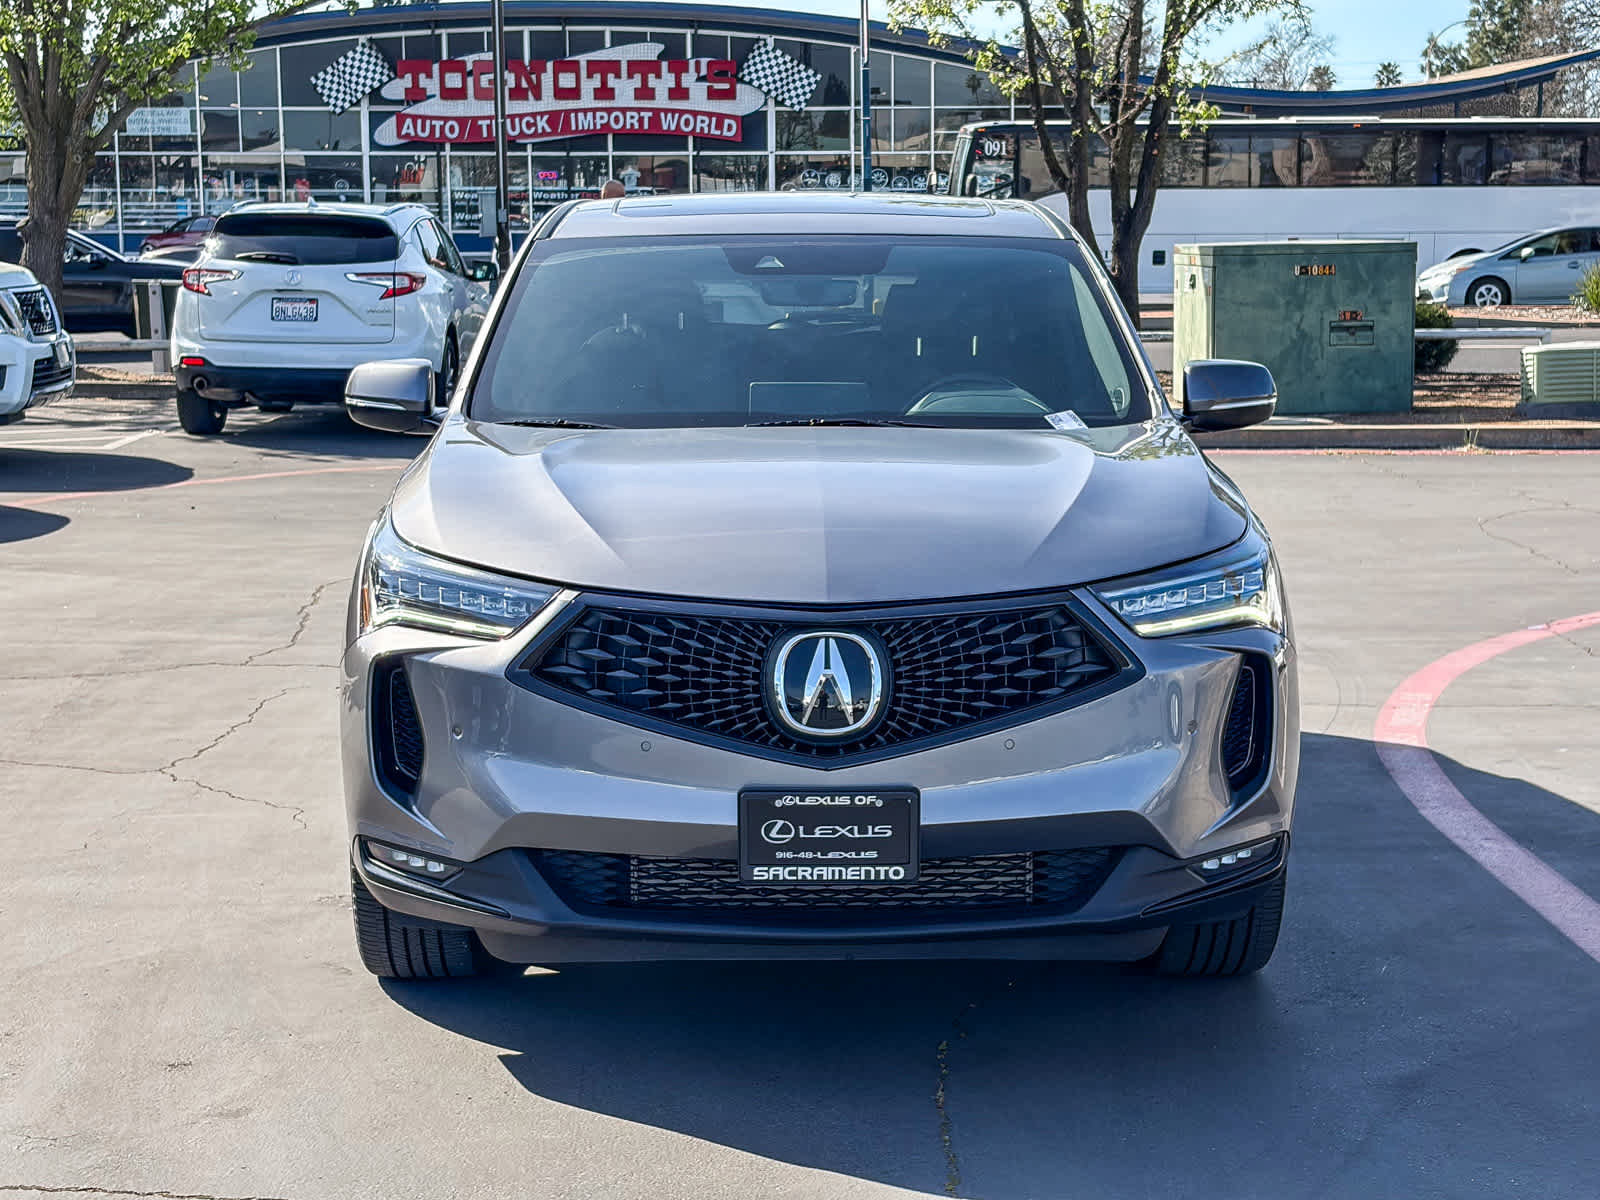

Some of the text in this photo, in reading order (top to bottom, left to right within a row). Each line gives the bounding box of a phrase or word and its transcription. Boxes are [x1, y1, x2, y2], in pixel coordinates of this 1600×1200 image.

[397, 59, 737, 101] TOGNOTTI'S
[401, 117, 460, 139] AUTO
[570, 111, 653, 131] IMPORT
[659, 112, 737, 137] WORLD
[984, 140, 1007, 157] 091
[274, 306, 315, 320] 8NLG438
[796, 796, 876, 805] LEXUS OF
[799, 825, 893, 838] LEXUS
[775, 851, 878, 859] 916-48-LEXUS
[752, 867, 905, 880] SACRAMENTO
